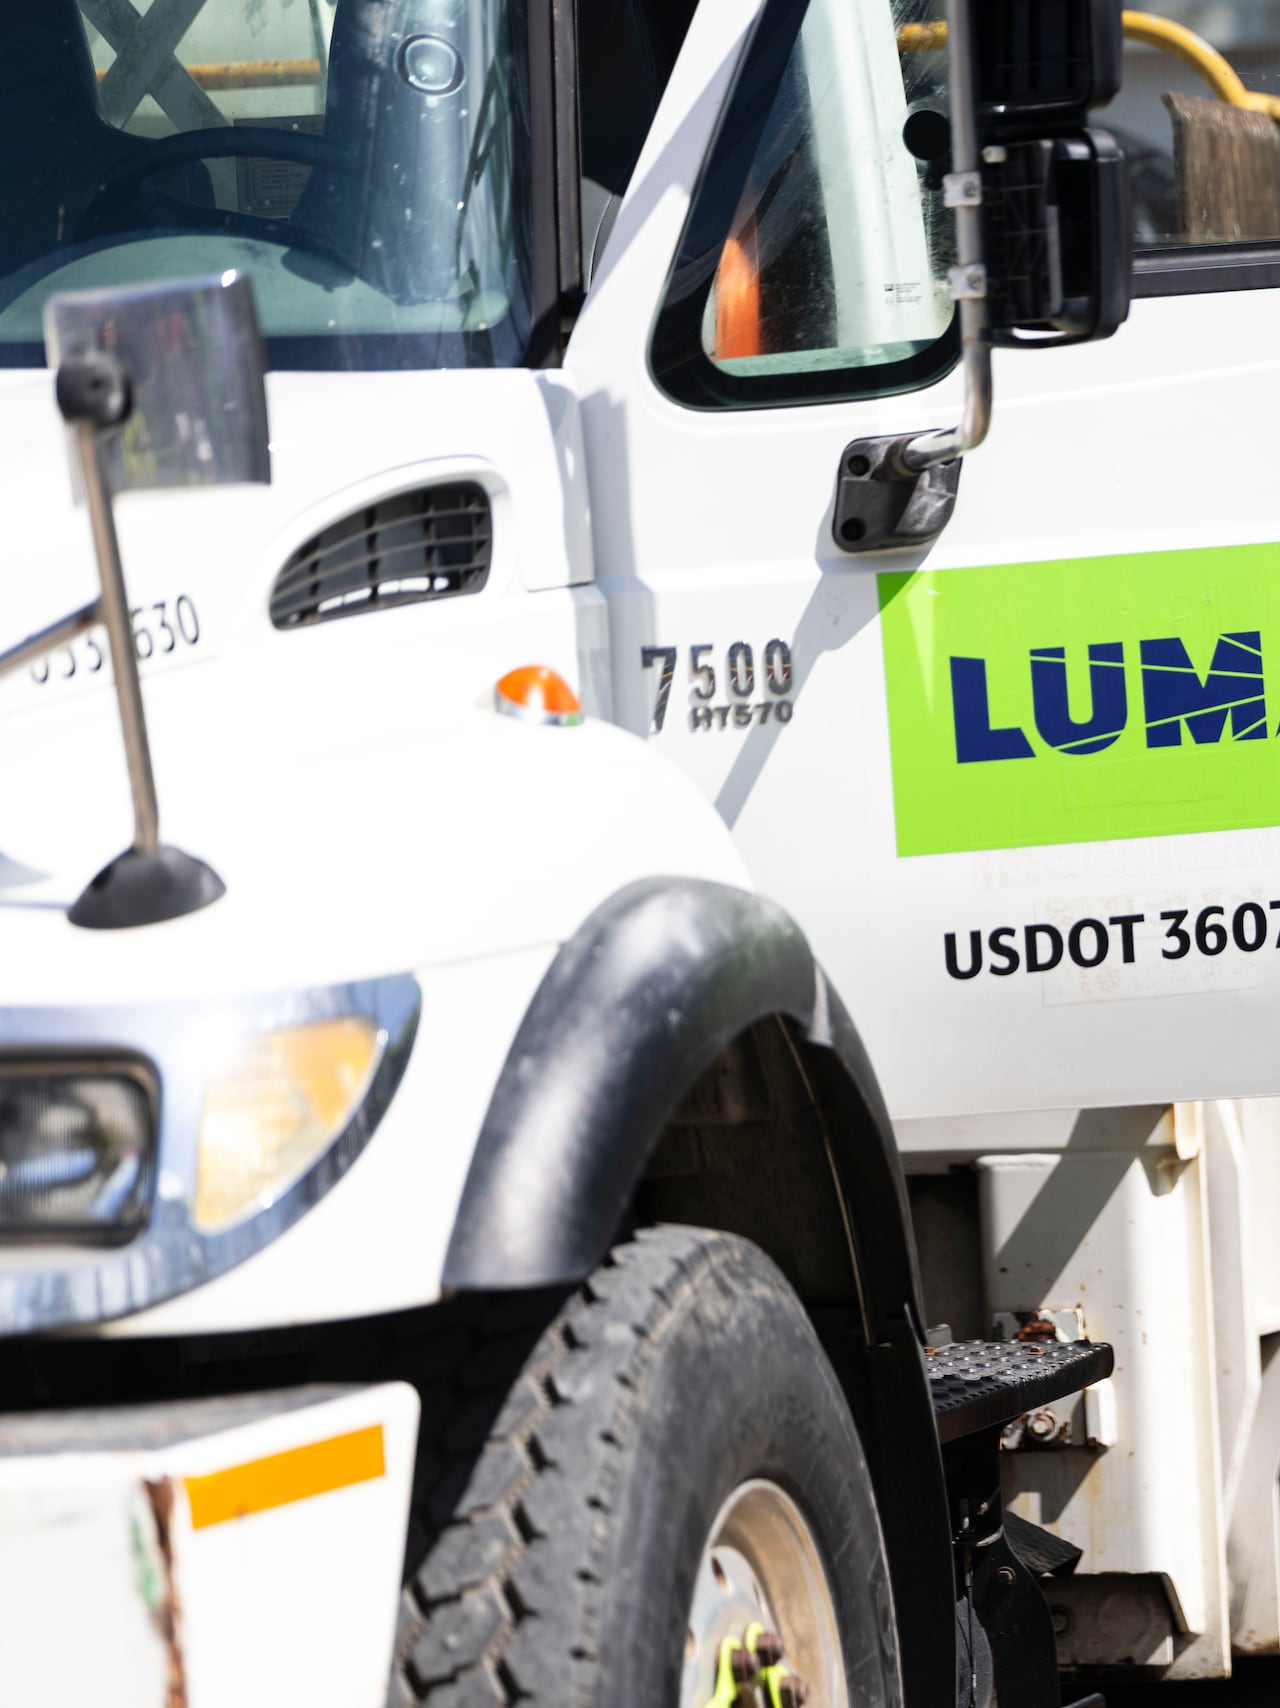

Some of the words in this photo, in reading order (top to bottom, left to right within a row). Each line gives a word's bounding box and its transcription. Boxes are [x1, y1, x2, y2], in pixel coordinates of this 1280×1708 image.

[641, 638, 794, 734] 7500
[691, 700, 794, 731] HT570
[944, 913, 1146, 980] USDOT
